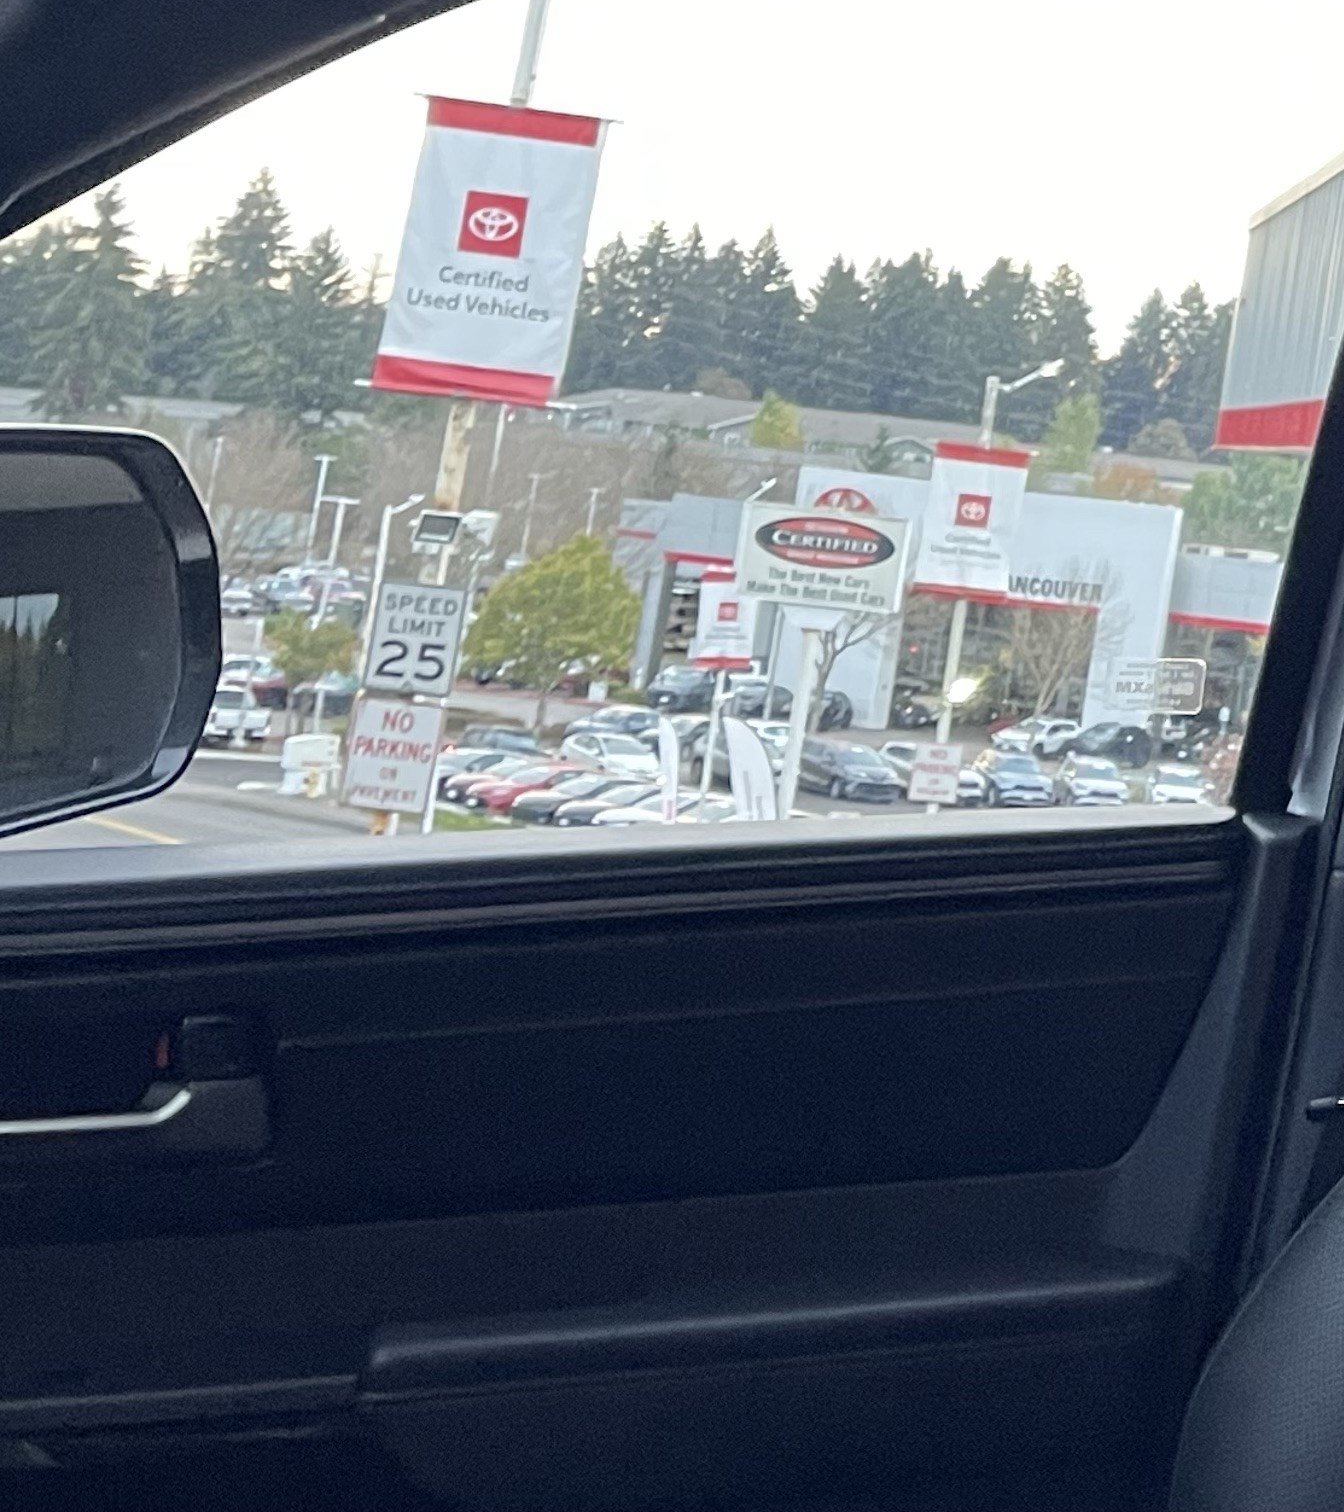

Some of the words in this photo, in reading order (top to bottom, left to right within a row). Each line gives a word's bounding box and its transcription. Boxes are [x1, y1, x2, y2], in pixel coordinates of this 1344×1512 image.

[439, 266, 529, 292] Certified
[407, 287, 461, 311] Used
[466, 294, 549, 322] Vehicles
[771, 529, 878, 554] CERTIFIED
[386, 593, 458, 616] SPEED
[388, 616, 446, 637] LIMIT
[375, 640, 447, 681] 25
[382, 709, 414, 733] NO
[354, 735, 432, 763] PARKING
